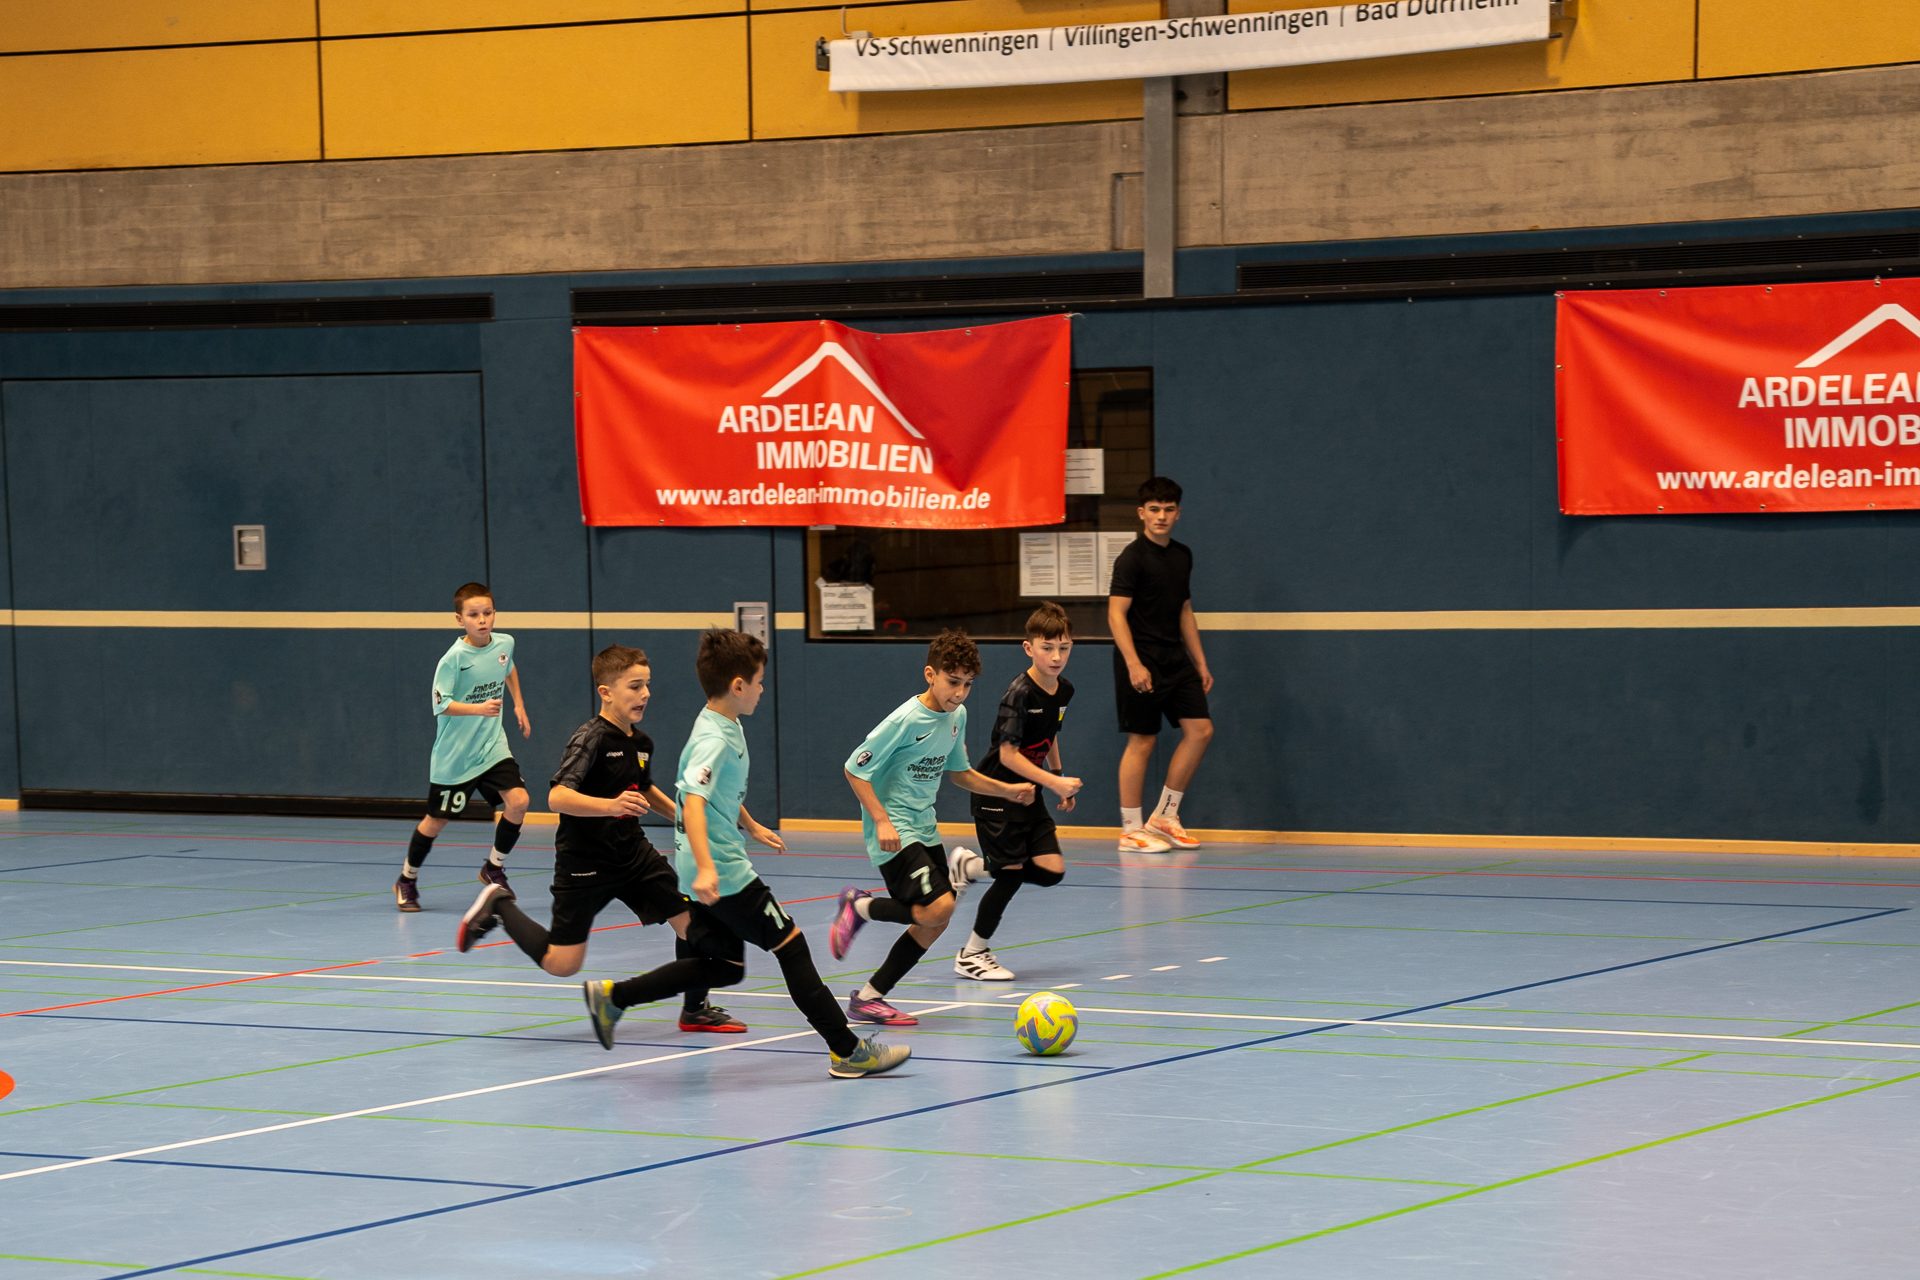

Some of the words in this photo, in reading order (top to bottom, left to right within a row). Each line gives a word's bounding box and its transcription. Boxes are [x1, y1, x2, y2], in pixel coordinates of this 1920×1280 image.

[855, 33, 1038, 56] VS-Schwenningen
[1064, 11, 1328, 48] Villingen-Schwenningen
[1356, 3, 1398, 22] Bad
[1738, 372, 1920, 408] ARDELEA
[717, 402, 875, 433] ARDELEAN
[756, 439, 933, 474] IMMOBILIEN
[656, 481, 991, 510] www.ardelean-immobilien.de
[439, 789, 467, 813] 19
[909, 865, 933, 896] 7
[763, 900, 791, 930] 1
